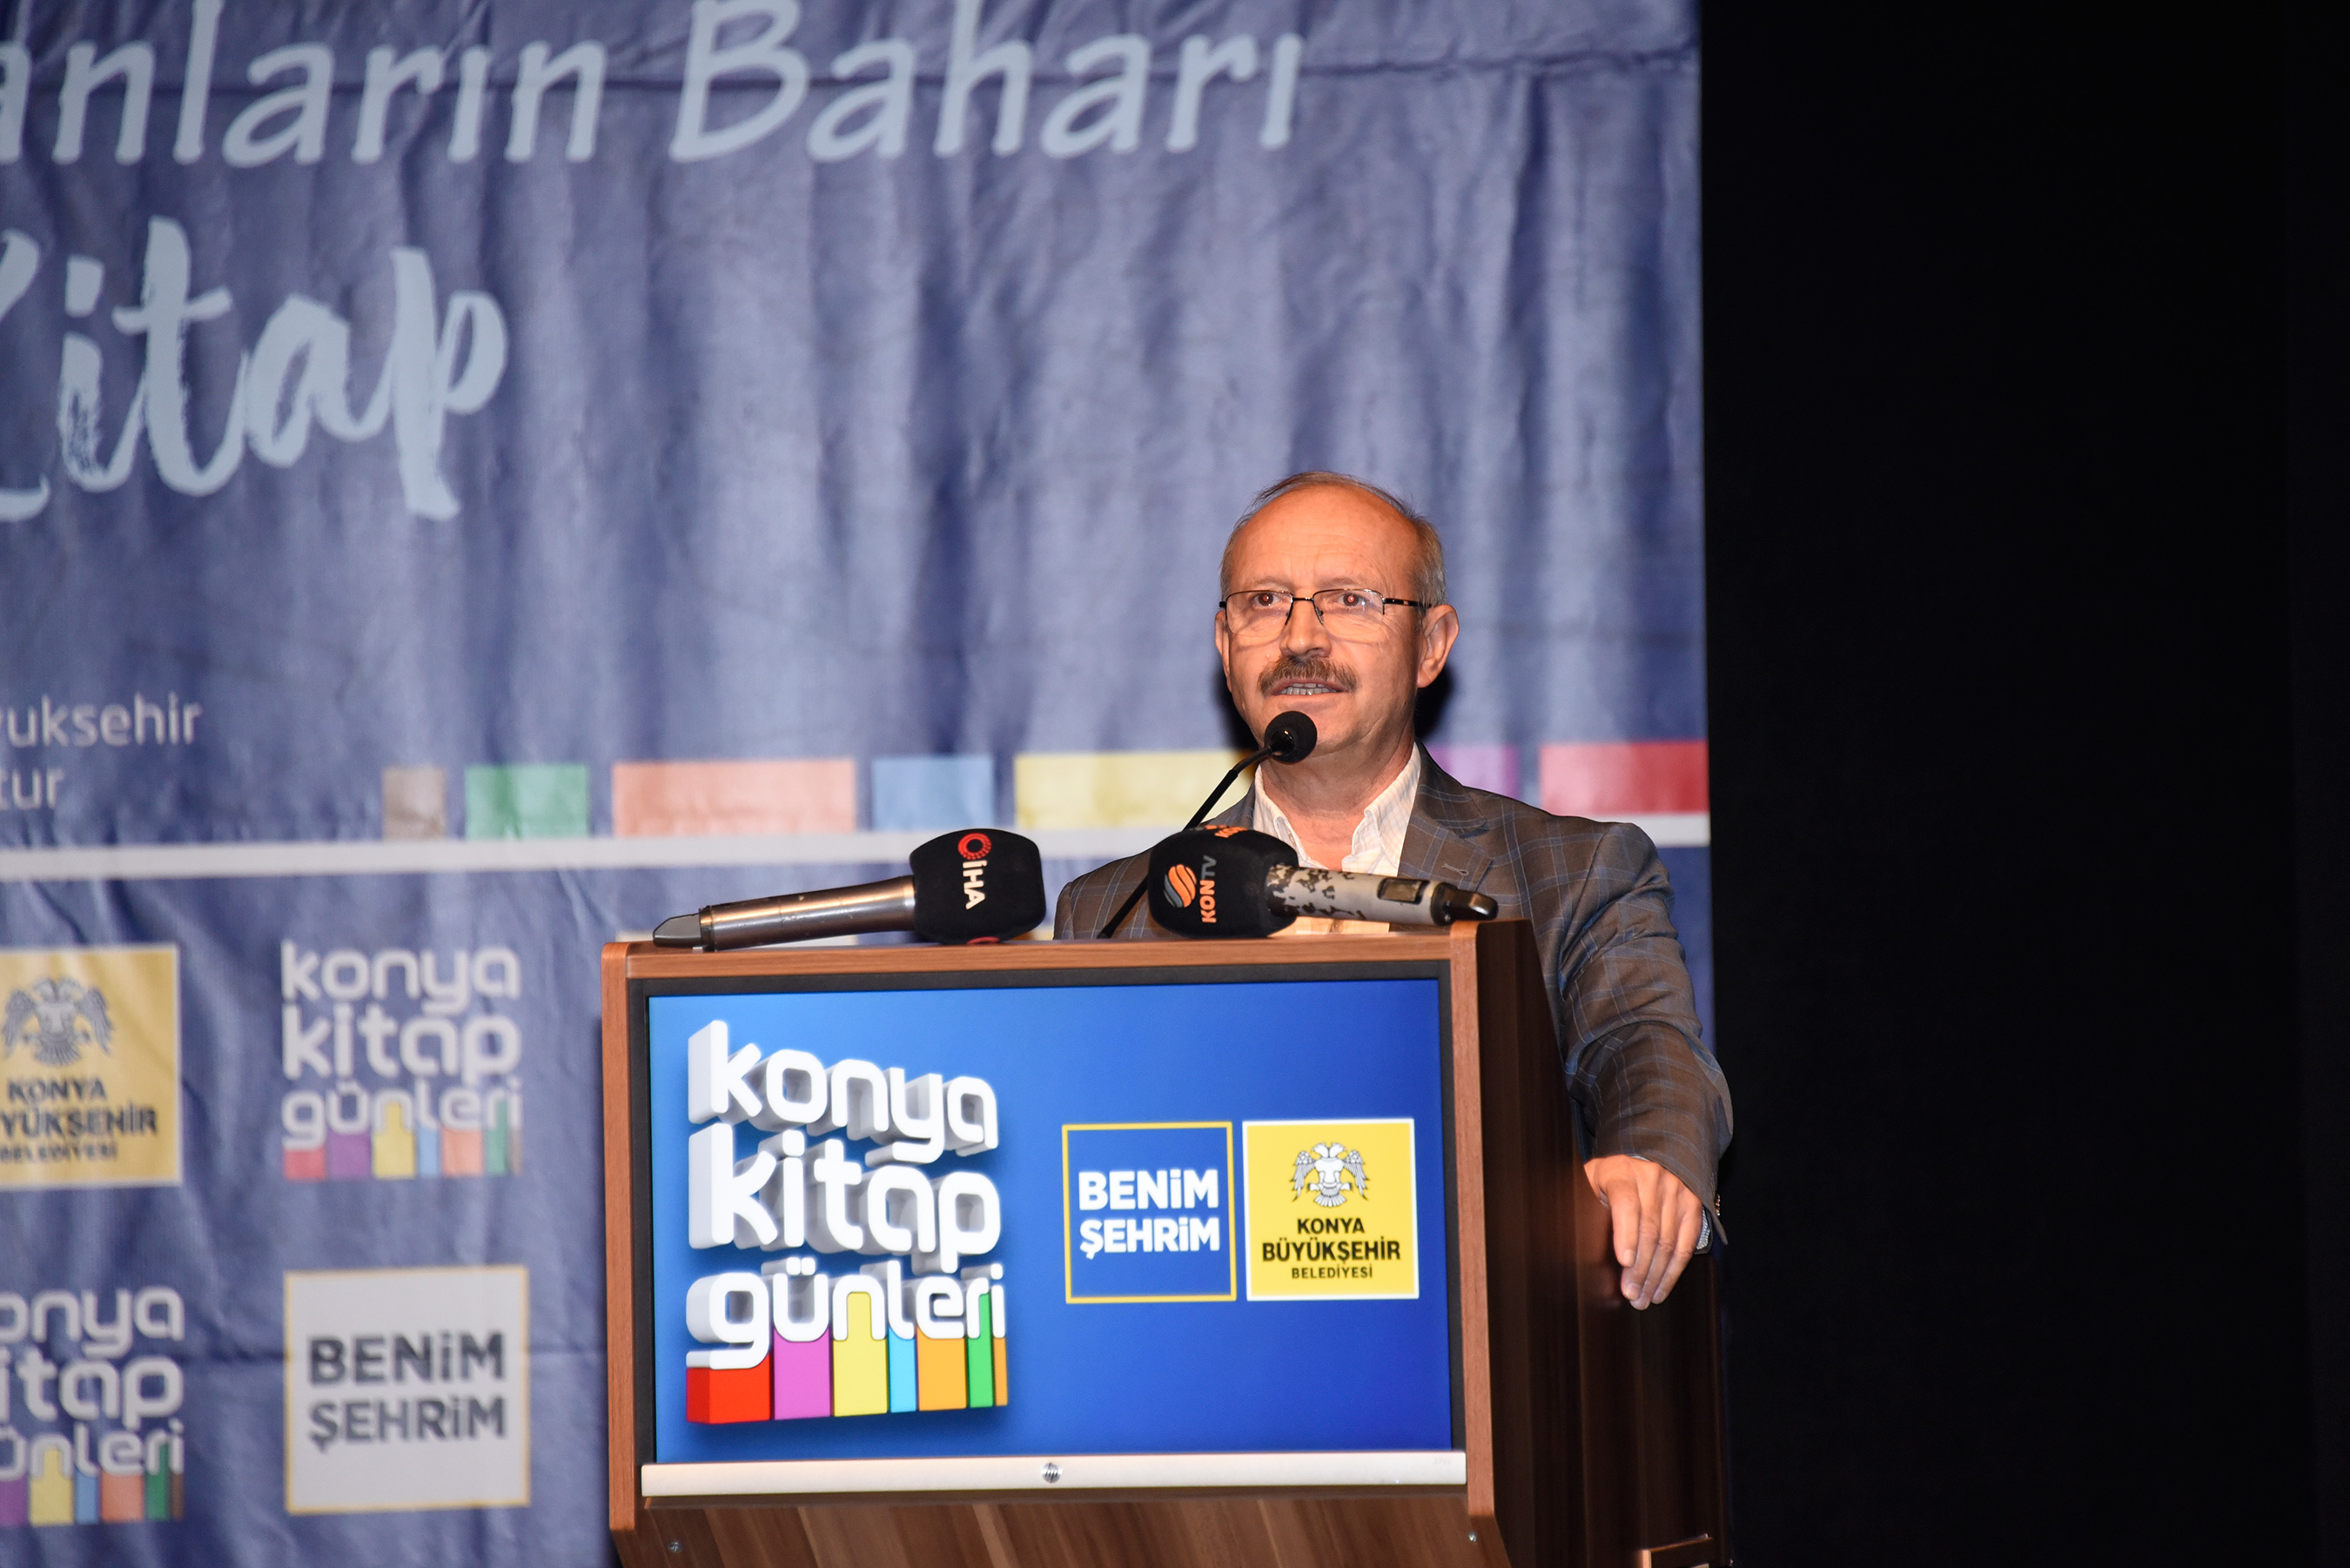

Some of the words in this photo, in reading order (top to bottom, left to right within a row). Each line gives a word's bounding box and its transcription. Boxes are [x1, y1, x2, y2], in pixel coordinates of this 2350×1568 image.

[0, 216, 508, 521] itap
[0, 693, 203, 747] uksehir
[281, 940, 520, 1015] konya
[281, 1003, 522, 1084] kitap
[280, 1077, 520, 1150] günleri
[688, 1020, 998, 1165] konya
[688, 1122, 1002, 1274] kitap
[1297, 1217, 1366, 1235] KONYA
[1262, 1236, 1401, 1265] BÜYÜKŞEHİR
[686, 1256, 1006, 1370] günleri
